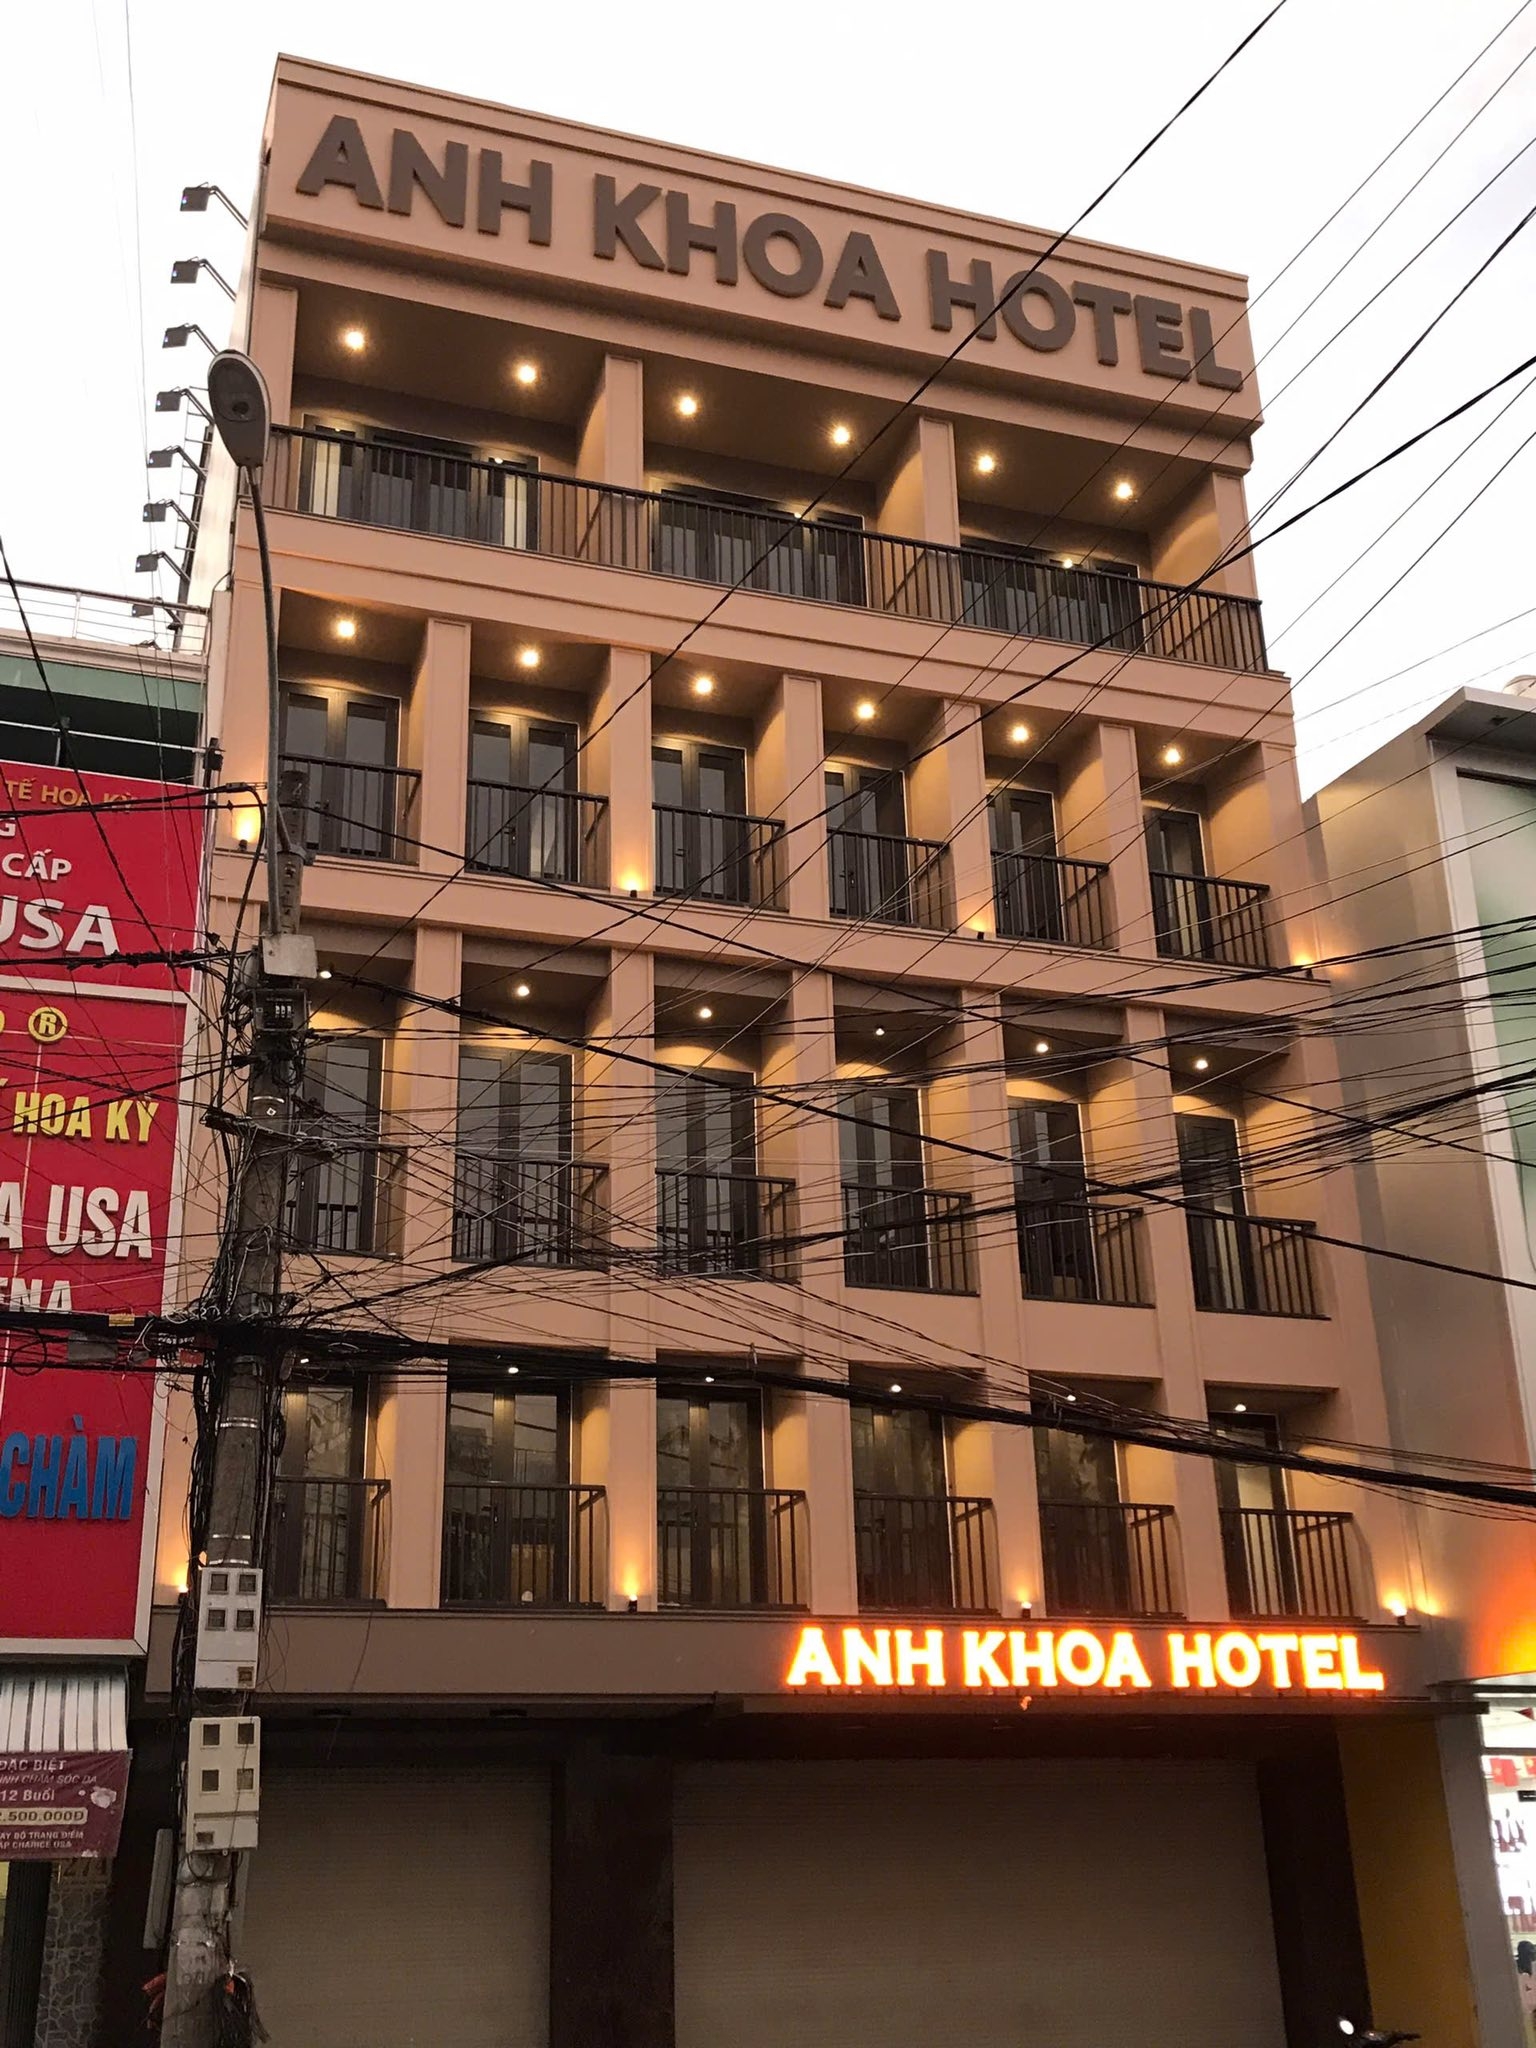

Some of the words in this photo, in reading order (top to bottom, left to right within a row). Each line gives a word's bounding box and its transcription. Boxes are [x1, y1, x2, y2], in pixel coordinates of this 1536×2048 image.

[295, 115, 553, 246] ANH
[593, 173, 902, 321] KHOA
[925, 249, 1244, 392] HOTEL
[41, 785, 92, 806] HOA
[2, 848, 72, 880] CẤP
[13, 1091, 92, 1138] HOA
[46, 1184, 153, 1258] USA
[0, 1413, 138, 1520] CHÀM
[786, 1627, 946, 1687] ANH
[961, 1629, 1152, 1689] KHOA
[1166, 1632, 1385, 1691] HOTEL
[33, 1757, 67, 1773] BIỆT
